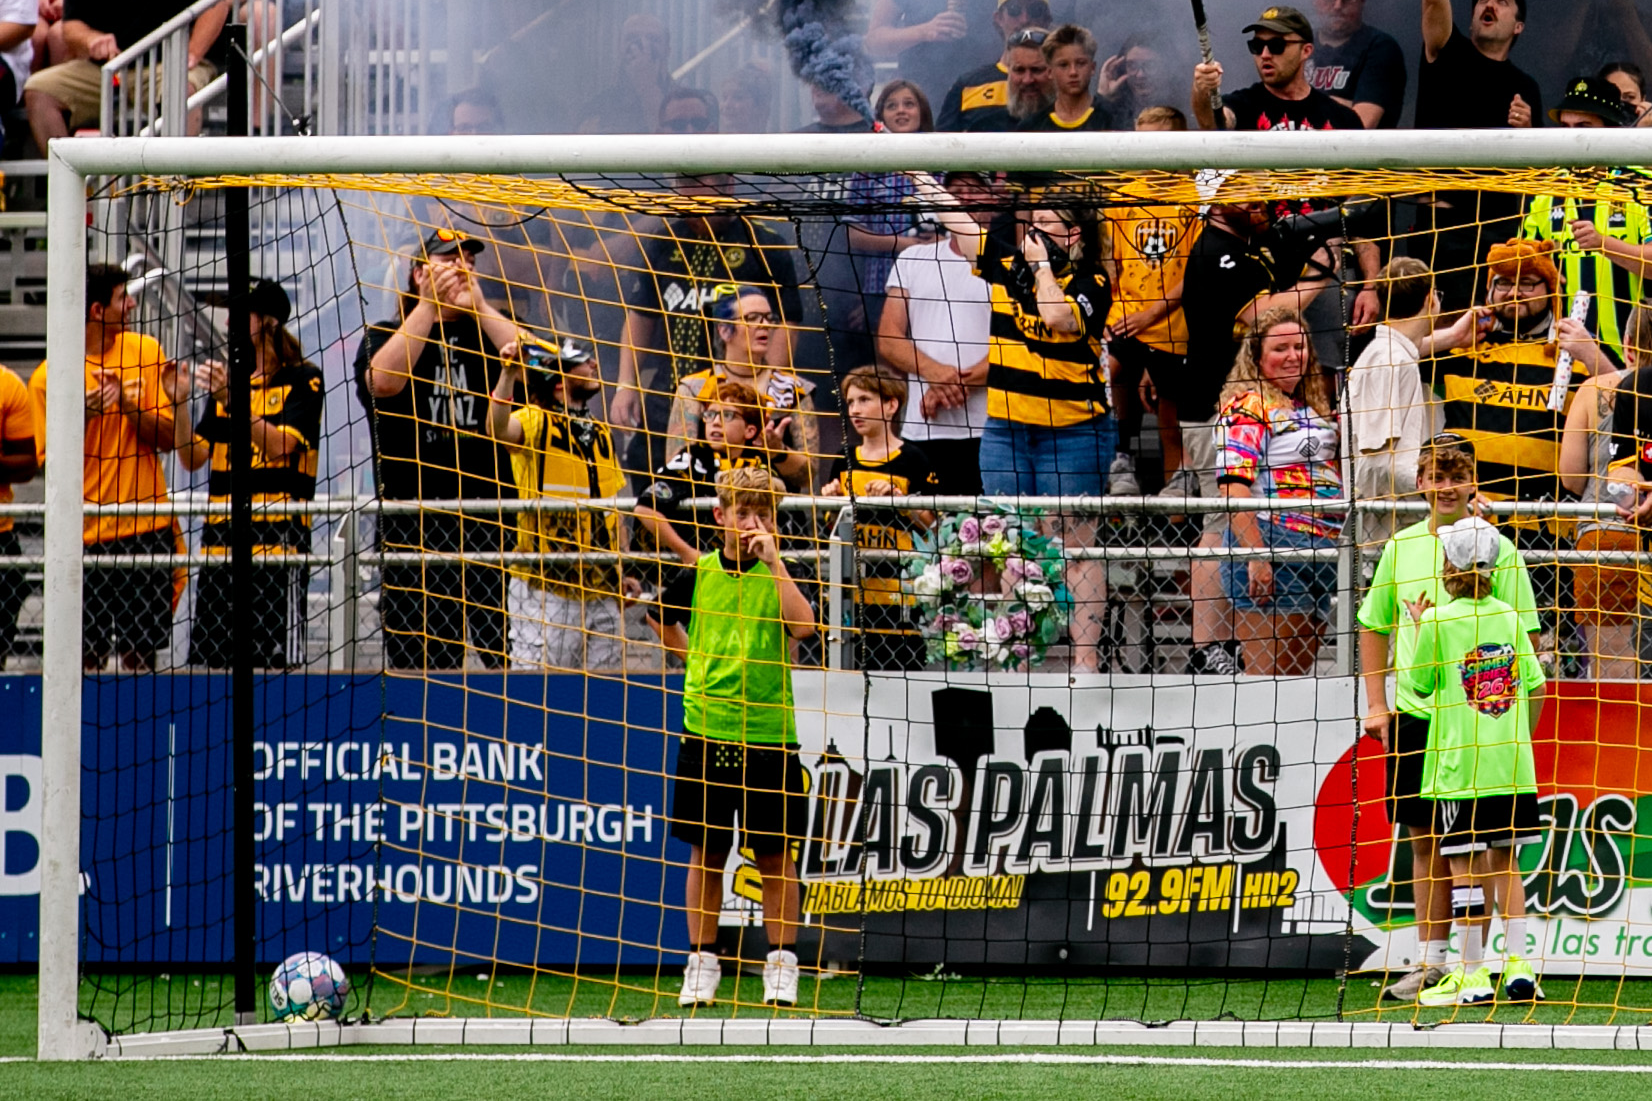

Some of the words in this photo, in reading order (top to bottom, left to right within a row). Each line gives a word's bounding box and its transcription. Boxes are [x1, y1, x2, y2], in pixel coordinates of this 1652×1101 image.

[680, 287, 716, 311] AH
[427, 394, 479, 427] YINZ
[1499, 384, 1550, 408] AHN
[1464, 656, 1510, 679] SUMMER
[1468, 667, 1508, 687] SERIES
[1477, 677, 1504, 700] 26
[253, 741, 422, 782] OFFICIAL
[433, 741, 544, 782] BANK
[308, 802, 389, 842] THE
[399, 802, 654, 844] PITTSBURGH
[803, 758, 962, 881] LAS
[966, 741, 1285, 877] PALMAS
[804, 879, 917, 916] HABLAMOS
[1102, 864, 1234, 920] 92.9FM
[1242, 870, 1300, 910] HD2
[1551, 919, 1601, 956] las
